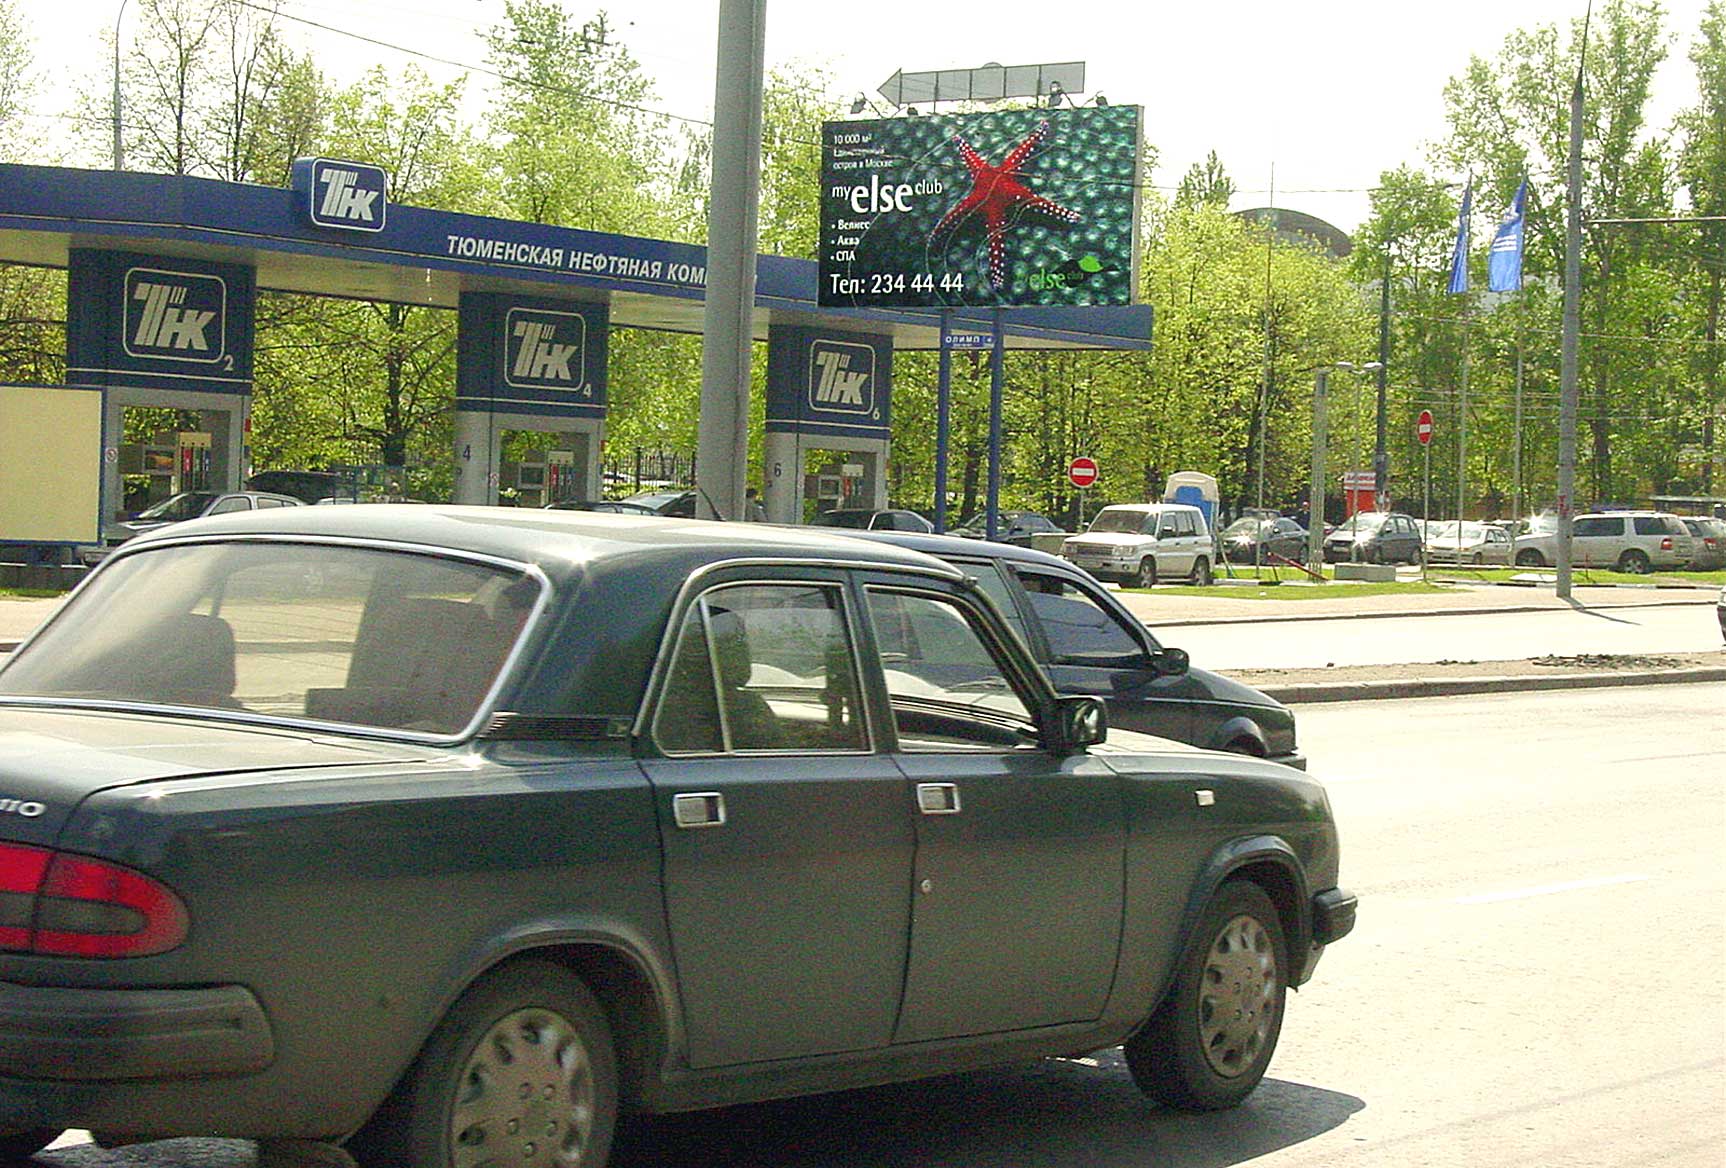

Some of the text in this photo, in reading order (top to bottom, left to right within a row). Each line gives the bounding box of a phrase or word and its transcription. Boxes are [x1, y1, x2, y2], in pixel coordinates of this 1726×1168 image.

[832, 174, 943, 214] my else club
[447, 234, 708, 286] ТЮМЕНСКАЯ НЕФТЯНАЯ КОМ
[829, 272, 965, 295] Тел: 234 44 44
[223, 354, 234, 371] 2
[582, 383, 593, 399] 4
[872, 407, 881, 420] 6
[462, 444, 472, 461] 4
[773, 462, 783, 478] 6
